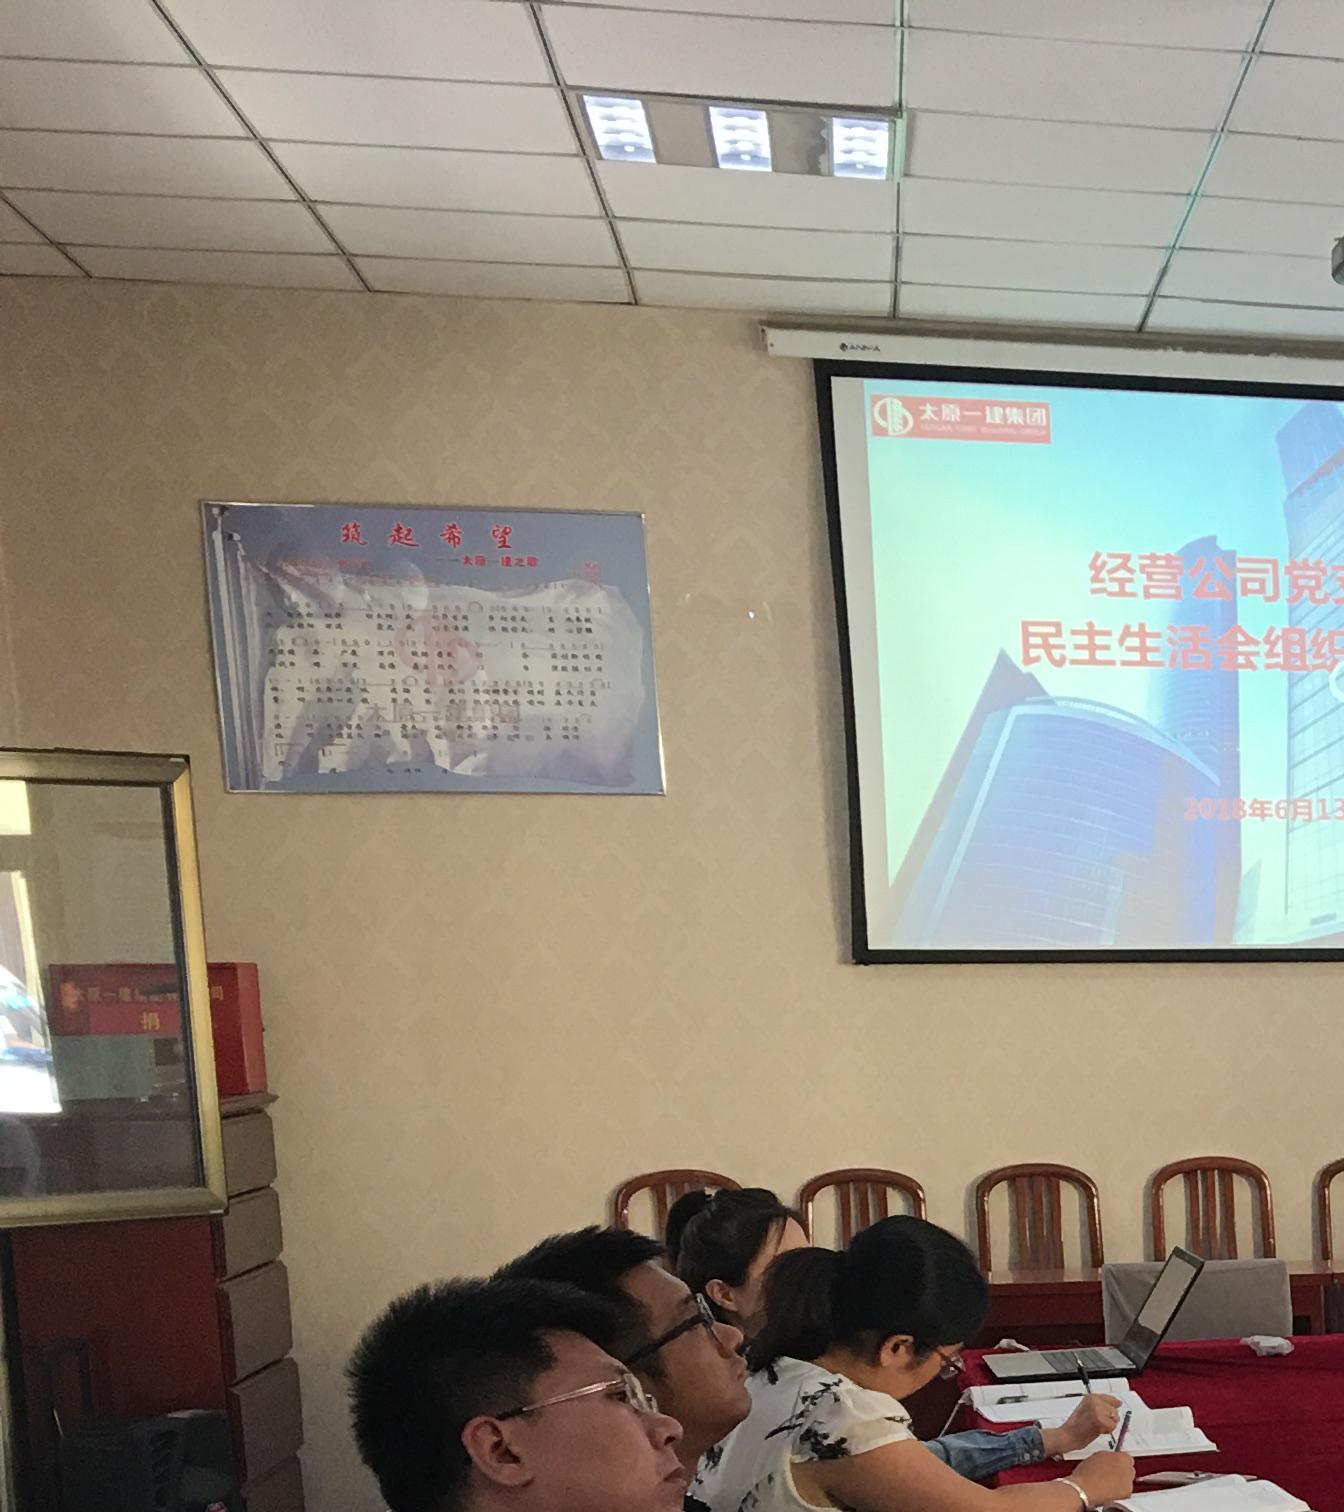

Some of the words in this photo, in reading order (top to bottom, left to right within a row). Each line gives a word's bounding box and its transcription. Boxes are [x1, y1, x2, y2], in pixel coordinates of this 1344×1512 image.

[919, 402, 1047, 426] 太原一建集团
